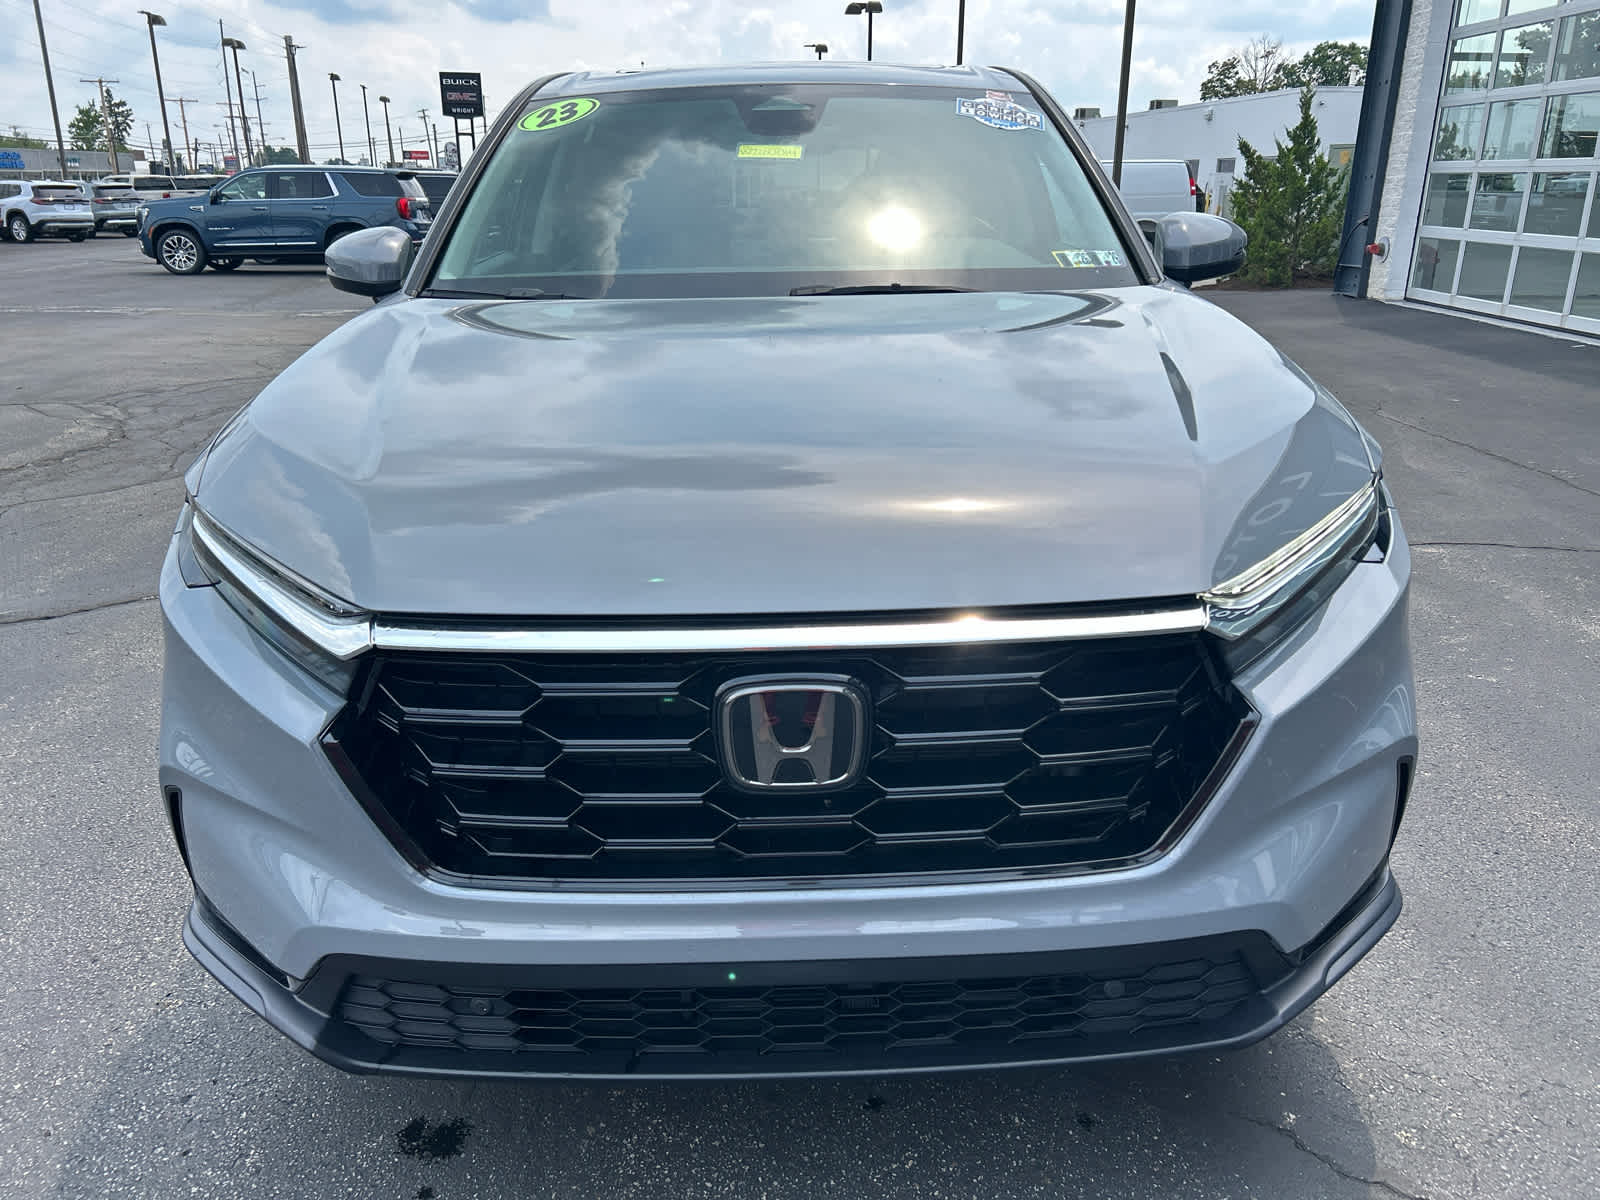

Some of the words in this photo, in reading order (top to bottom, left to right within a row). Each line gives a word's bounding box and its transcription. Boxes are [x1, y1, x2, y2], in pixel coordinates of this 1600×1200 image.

[442, 78, 478, 86] BUICK
[446, 92, 477, 101] GMC
[536, 102, 579, 128] 23
[961, 100, 1041, 121] CARFAX
